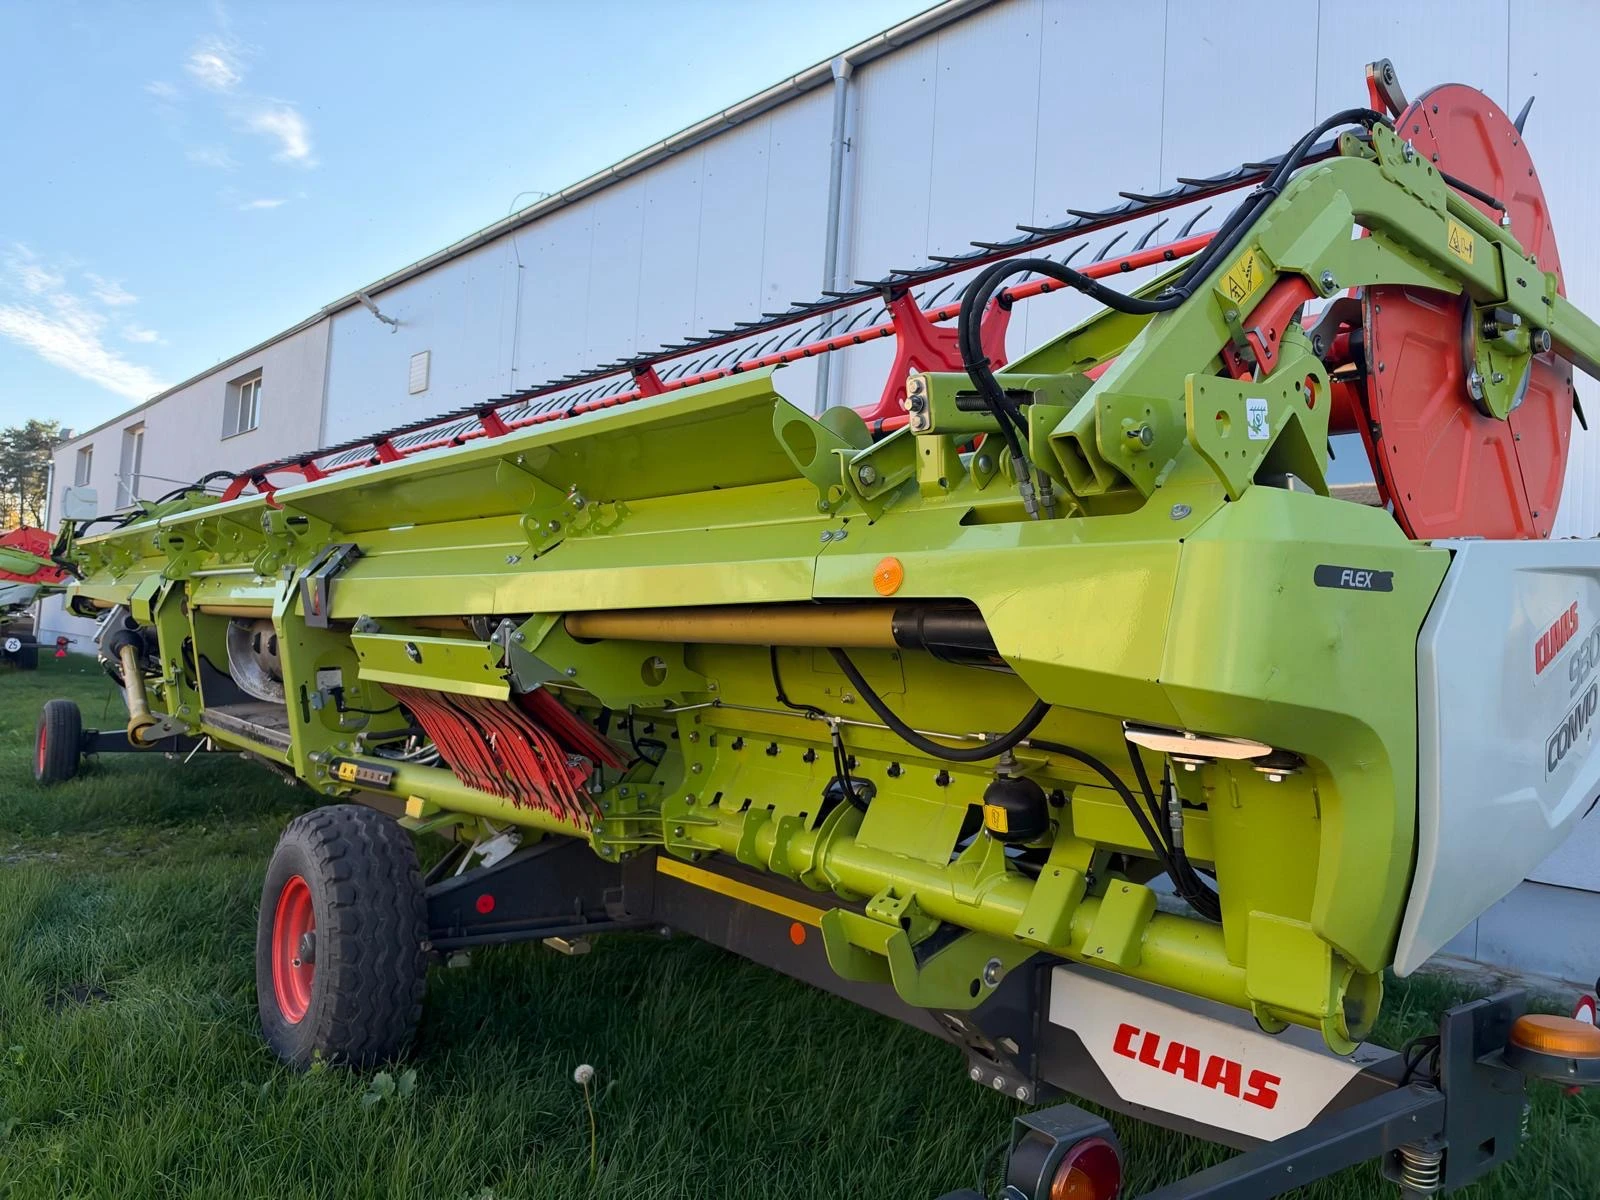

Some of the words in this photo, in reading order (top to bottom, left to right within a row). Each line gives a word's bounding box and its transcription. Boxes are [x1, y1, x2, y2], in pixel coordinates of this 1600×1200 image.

[1341, 570, 1373, 588] FLEX
[1535, 600, 1579, 675] CLAAS
[1569, 624, 1600, 699] 930
[1548, 683, 1598, 773] CONVIO
[1113, 1023, 1281, 1110] CLAAS
